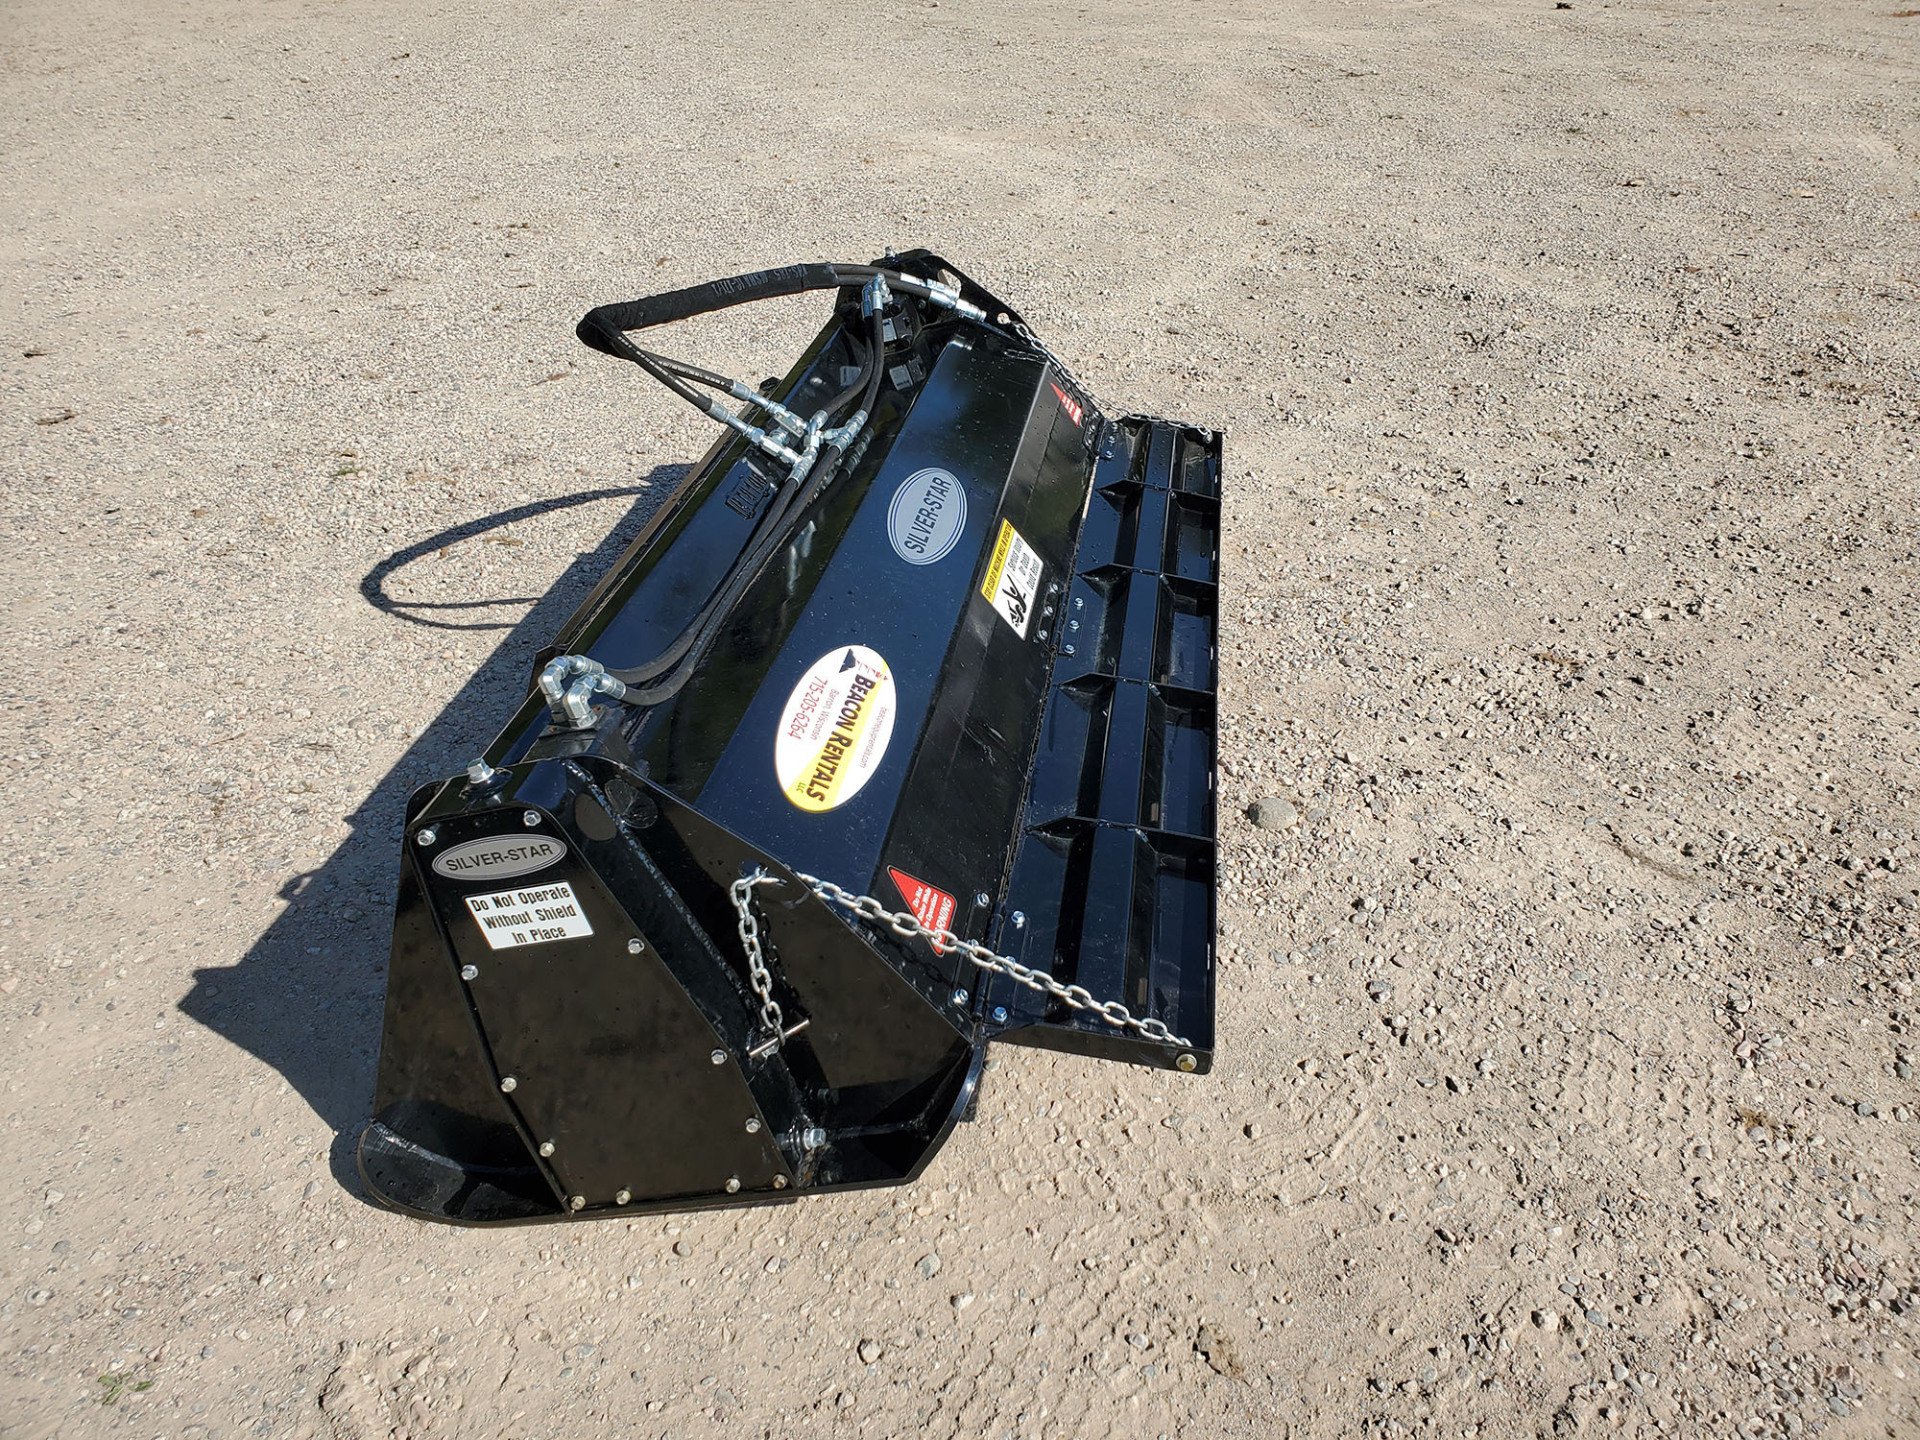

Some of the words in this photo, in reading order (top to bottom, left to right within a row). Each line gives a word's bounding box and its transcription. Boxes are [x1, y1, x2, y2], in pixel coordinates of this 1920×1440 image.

[904, 477, 951, 553] SILVER-STAR
[788, 675, 828, 740] 715-205-6264
[835, 674, 876, 732] BEACON
[811, 711, 829, 741] Wisconsin
[806, 731, 854, 802] RENTALS
[796, 782, 807, 794] LLC
[446, 844, 554, 871] SILVER-STAR
[470, 899, 489, 912] Do
[492, 894, 516, 908] Not
[518, 886, 571, 904] Operate
[482, 911, 533, 929] Without
[536, 904, 577, 921] Shield
[511, 932, 528, 944] In
[529, 926, 567, 941] Place
